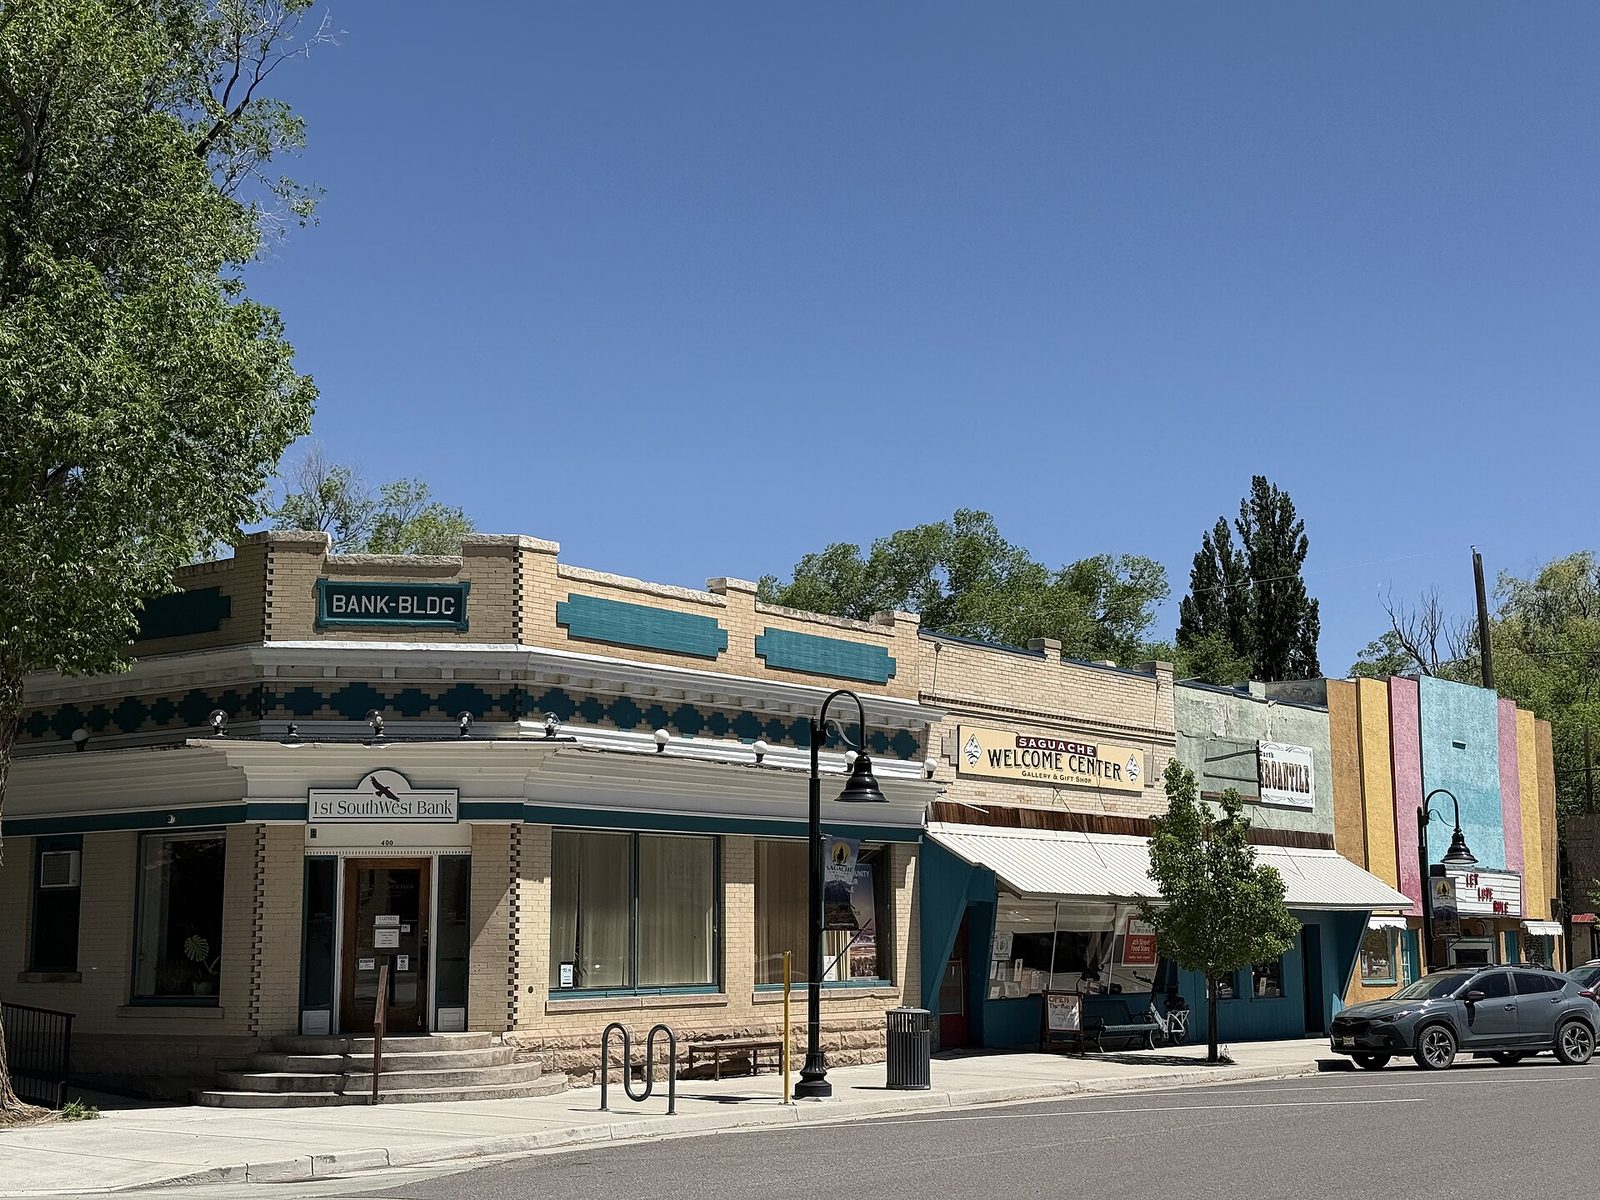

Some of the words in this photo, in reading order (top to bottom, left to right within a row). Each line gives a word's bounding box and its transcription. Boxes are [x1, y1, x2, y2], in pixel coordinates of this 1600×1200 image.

[332, 594, 455, 615] BANK-BLDG
[1018, 738, 1094, 756] SAGUACHE
[987, 749, 1064, 771] WELCOME
[1068, 755, 1123, 783] CENTER
[1021, 770, 1051, 779] GALLERY
[1059, 773, 1074, 782] GIFT
[1075, 776, 1092, 784] SHOP
[314, 801, 333, 814] 1st
[337, 800, 412, 815] SouthWest
[417, 799, 453, 814] Bank
[1466, 873, 1479, 888] LET
[1477, 887, 1493, 902] LOVE
[1493, 900, 1509, 915] RULE
